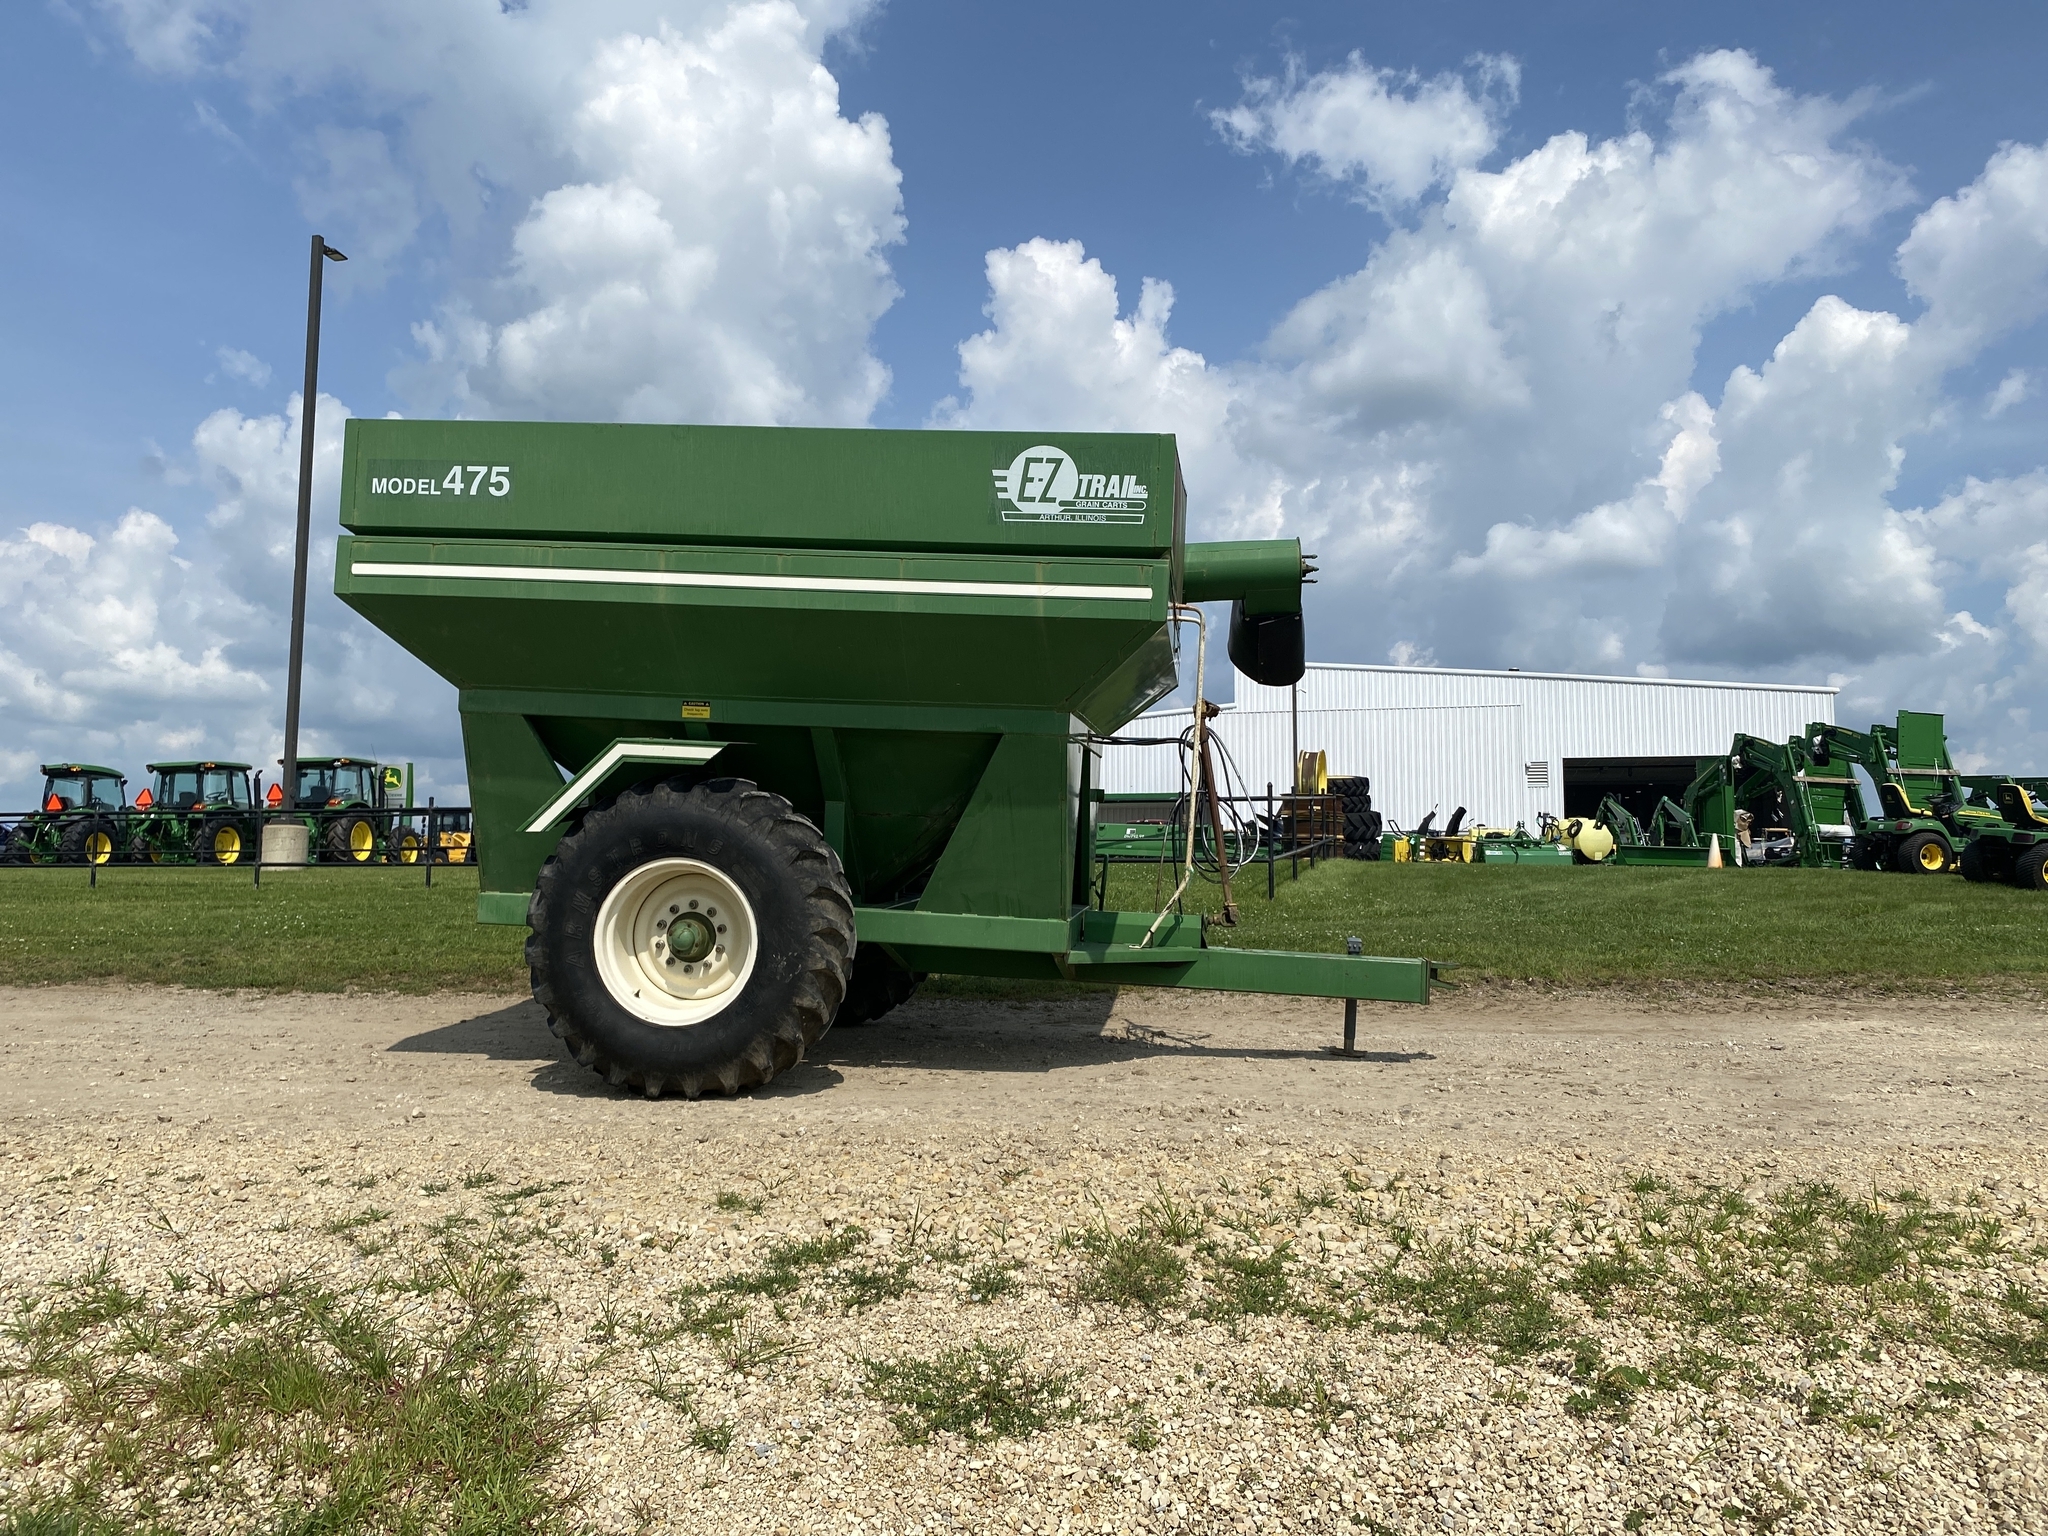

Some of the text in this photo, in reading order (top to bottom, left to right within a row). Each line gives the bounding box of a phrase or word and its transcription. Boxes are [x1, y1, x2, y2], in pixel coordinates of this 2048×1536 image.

[371, 465, 511, 497] MODEL 475
[1078, 474, 1148, 499] TRAIL
[1075, 500, 1128, 510] GRAIN CARTS
[1074, 514, 1107, 523] ILLINOIS
[565, 828, 725, 968] ARMSTRONG
